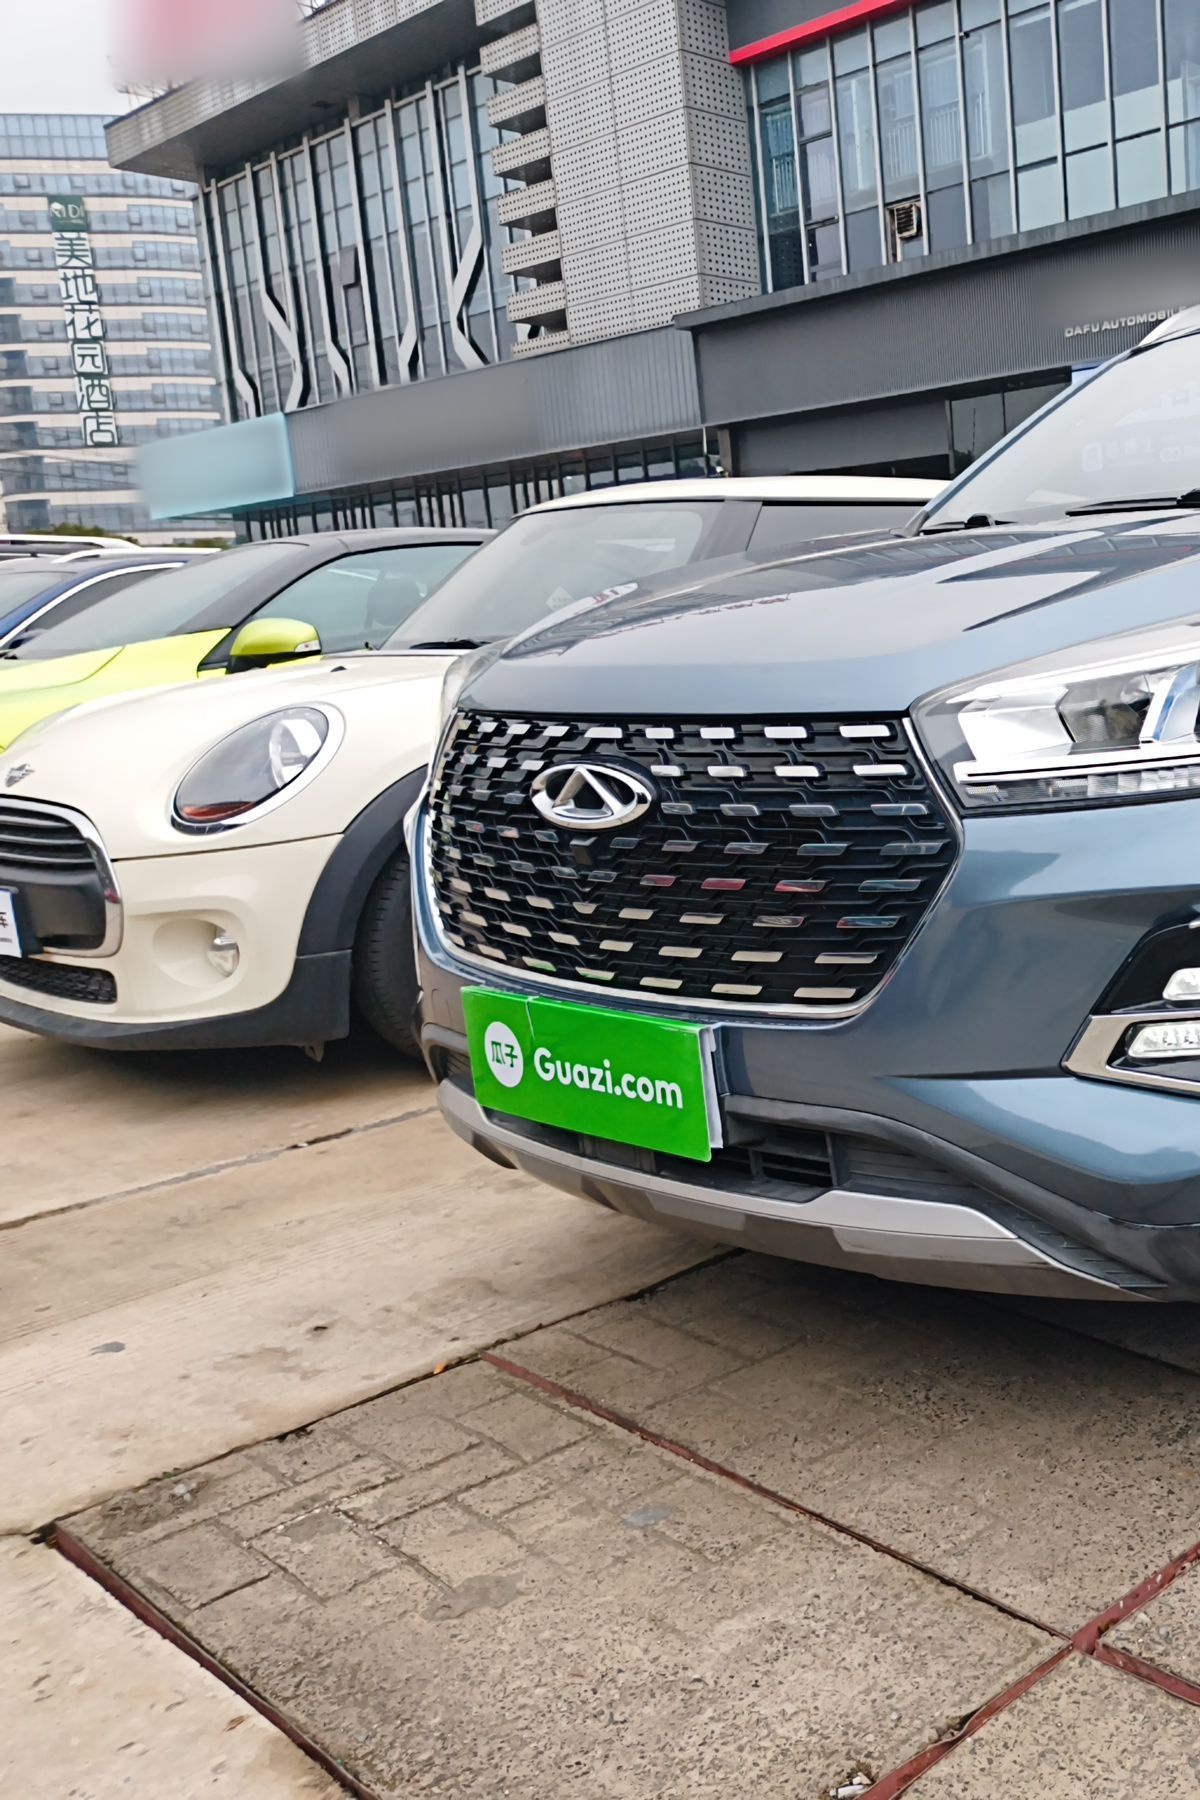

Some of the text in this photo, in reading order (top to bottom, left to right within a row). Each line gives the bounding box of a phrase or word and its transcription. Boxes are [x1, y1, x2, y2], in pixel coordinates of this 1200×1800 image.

[55, 233, 118, 446] 美地花园酒店
[1064, 323, 1100, 338] DAFU
[491, 1041, 518, 1068] 瓜子
[533, 1047, 683, 1110] Guazi.com
